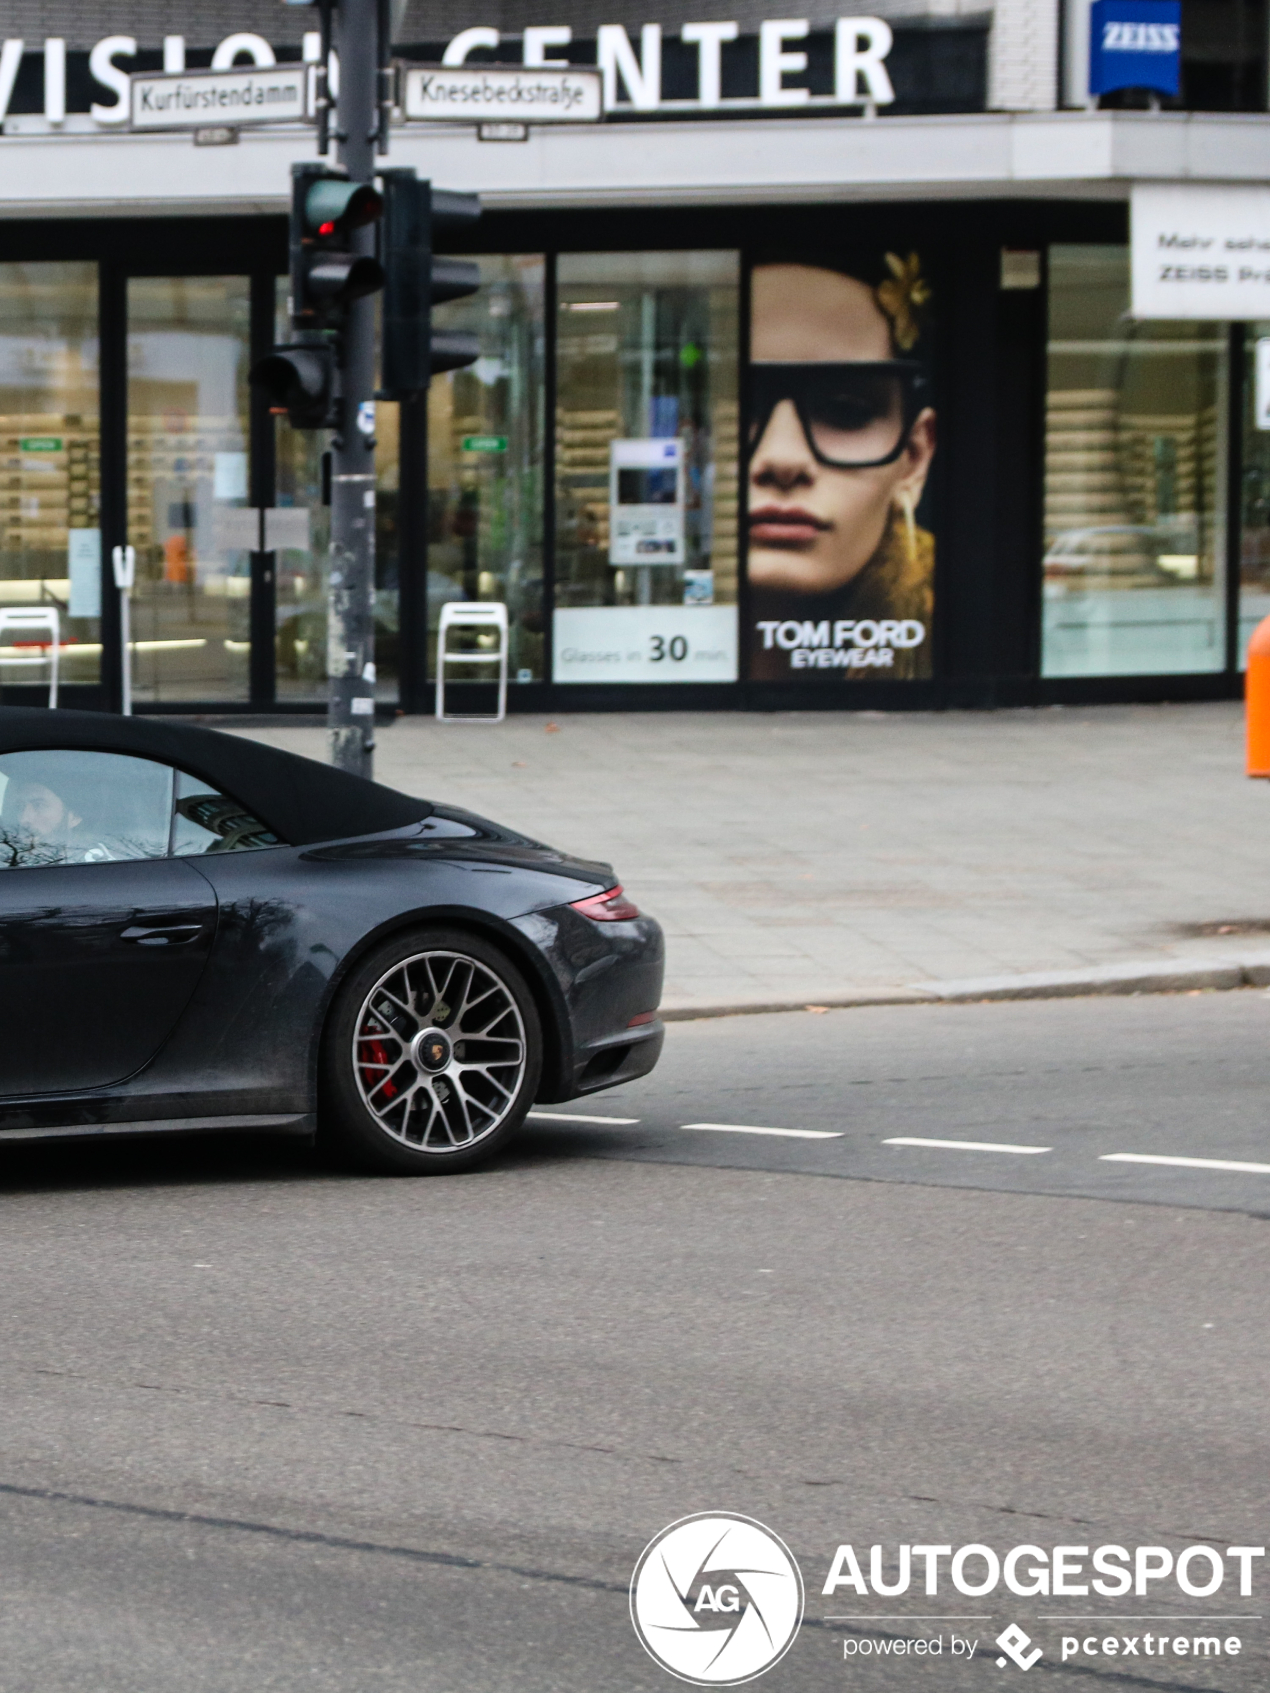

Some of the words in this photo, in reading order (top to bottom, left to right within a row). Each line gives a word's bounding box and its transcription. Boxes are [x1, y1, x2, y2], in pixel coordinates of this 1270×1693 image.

[1102, 22, 1179, 52] ZEISS
[141, 78, 297, 111] Kurfürstendamm
[421, 74, 585, 110] Knesebeckstraße
[1158, 266, 1229, 282] ZEISS
[648, 634, 688, 662] 30
[757, 620, 830, 649] TOM
[834, 620, 925, 648] FORD
[791, 649, 894, 668] EYEWEAR
